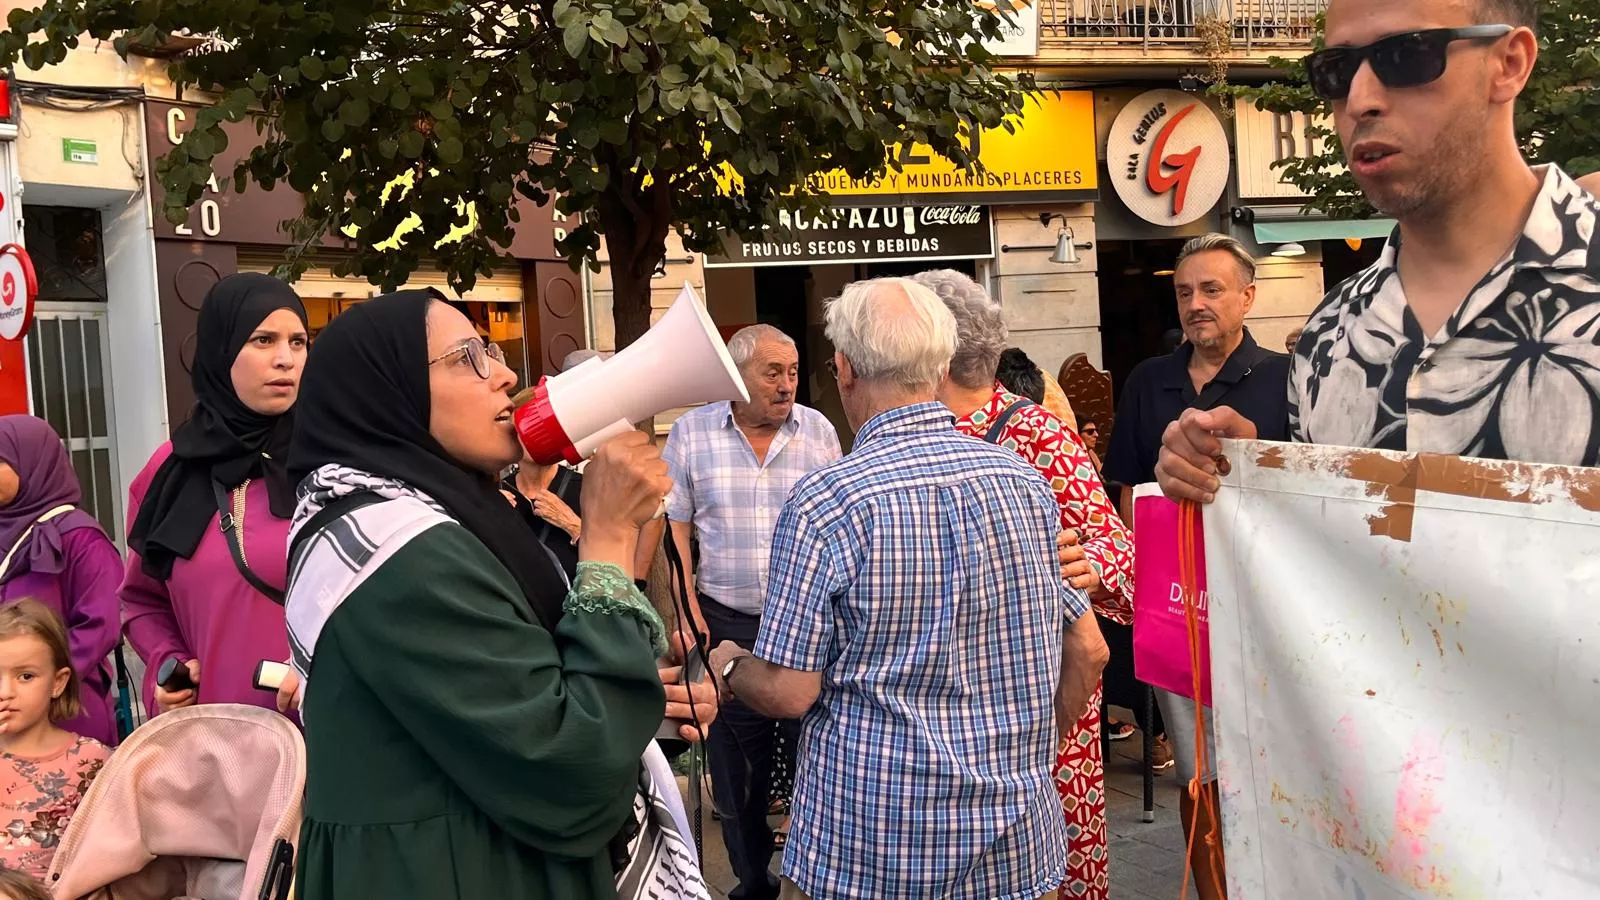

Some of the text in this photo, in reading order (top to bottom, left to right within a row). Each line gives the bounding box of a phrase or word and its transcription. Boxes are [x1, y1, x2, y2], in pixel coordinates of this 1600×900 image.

[1132, 102, 1166, 145] GENIUS
[889, 174, 897, 188] Y
[1003, 170, 1081, 186] PLACERES
[808, 240, 856, 255] SECOS
[862, 239, 871, 253] Y
[877, 237, 939, 253] BEBIDAS
